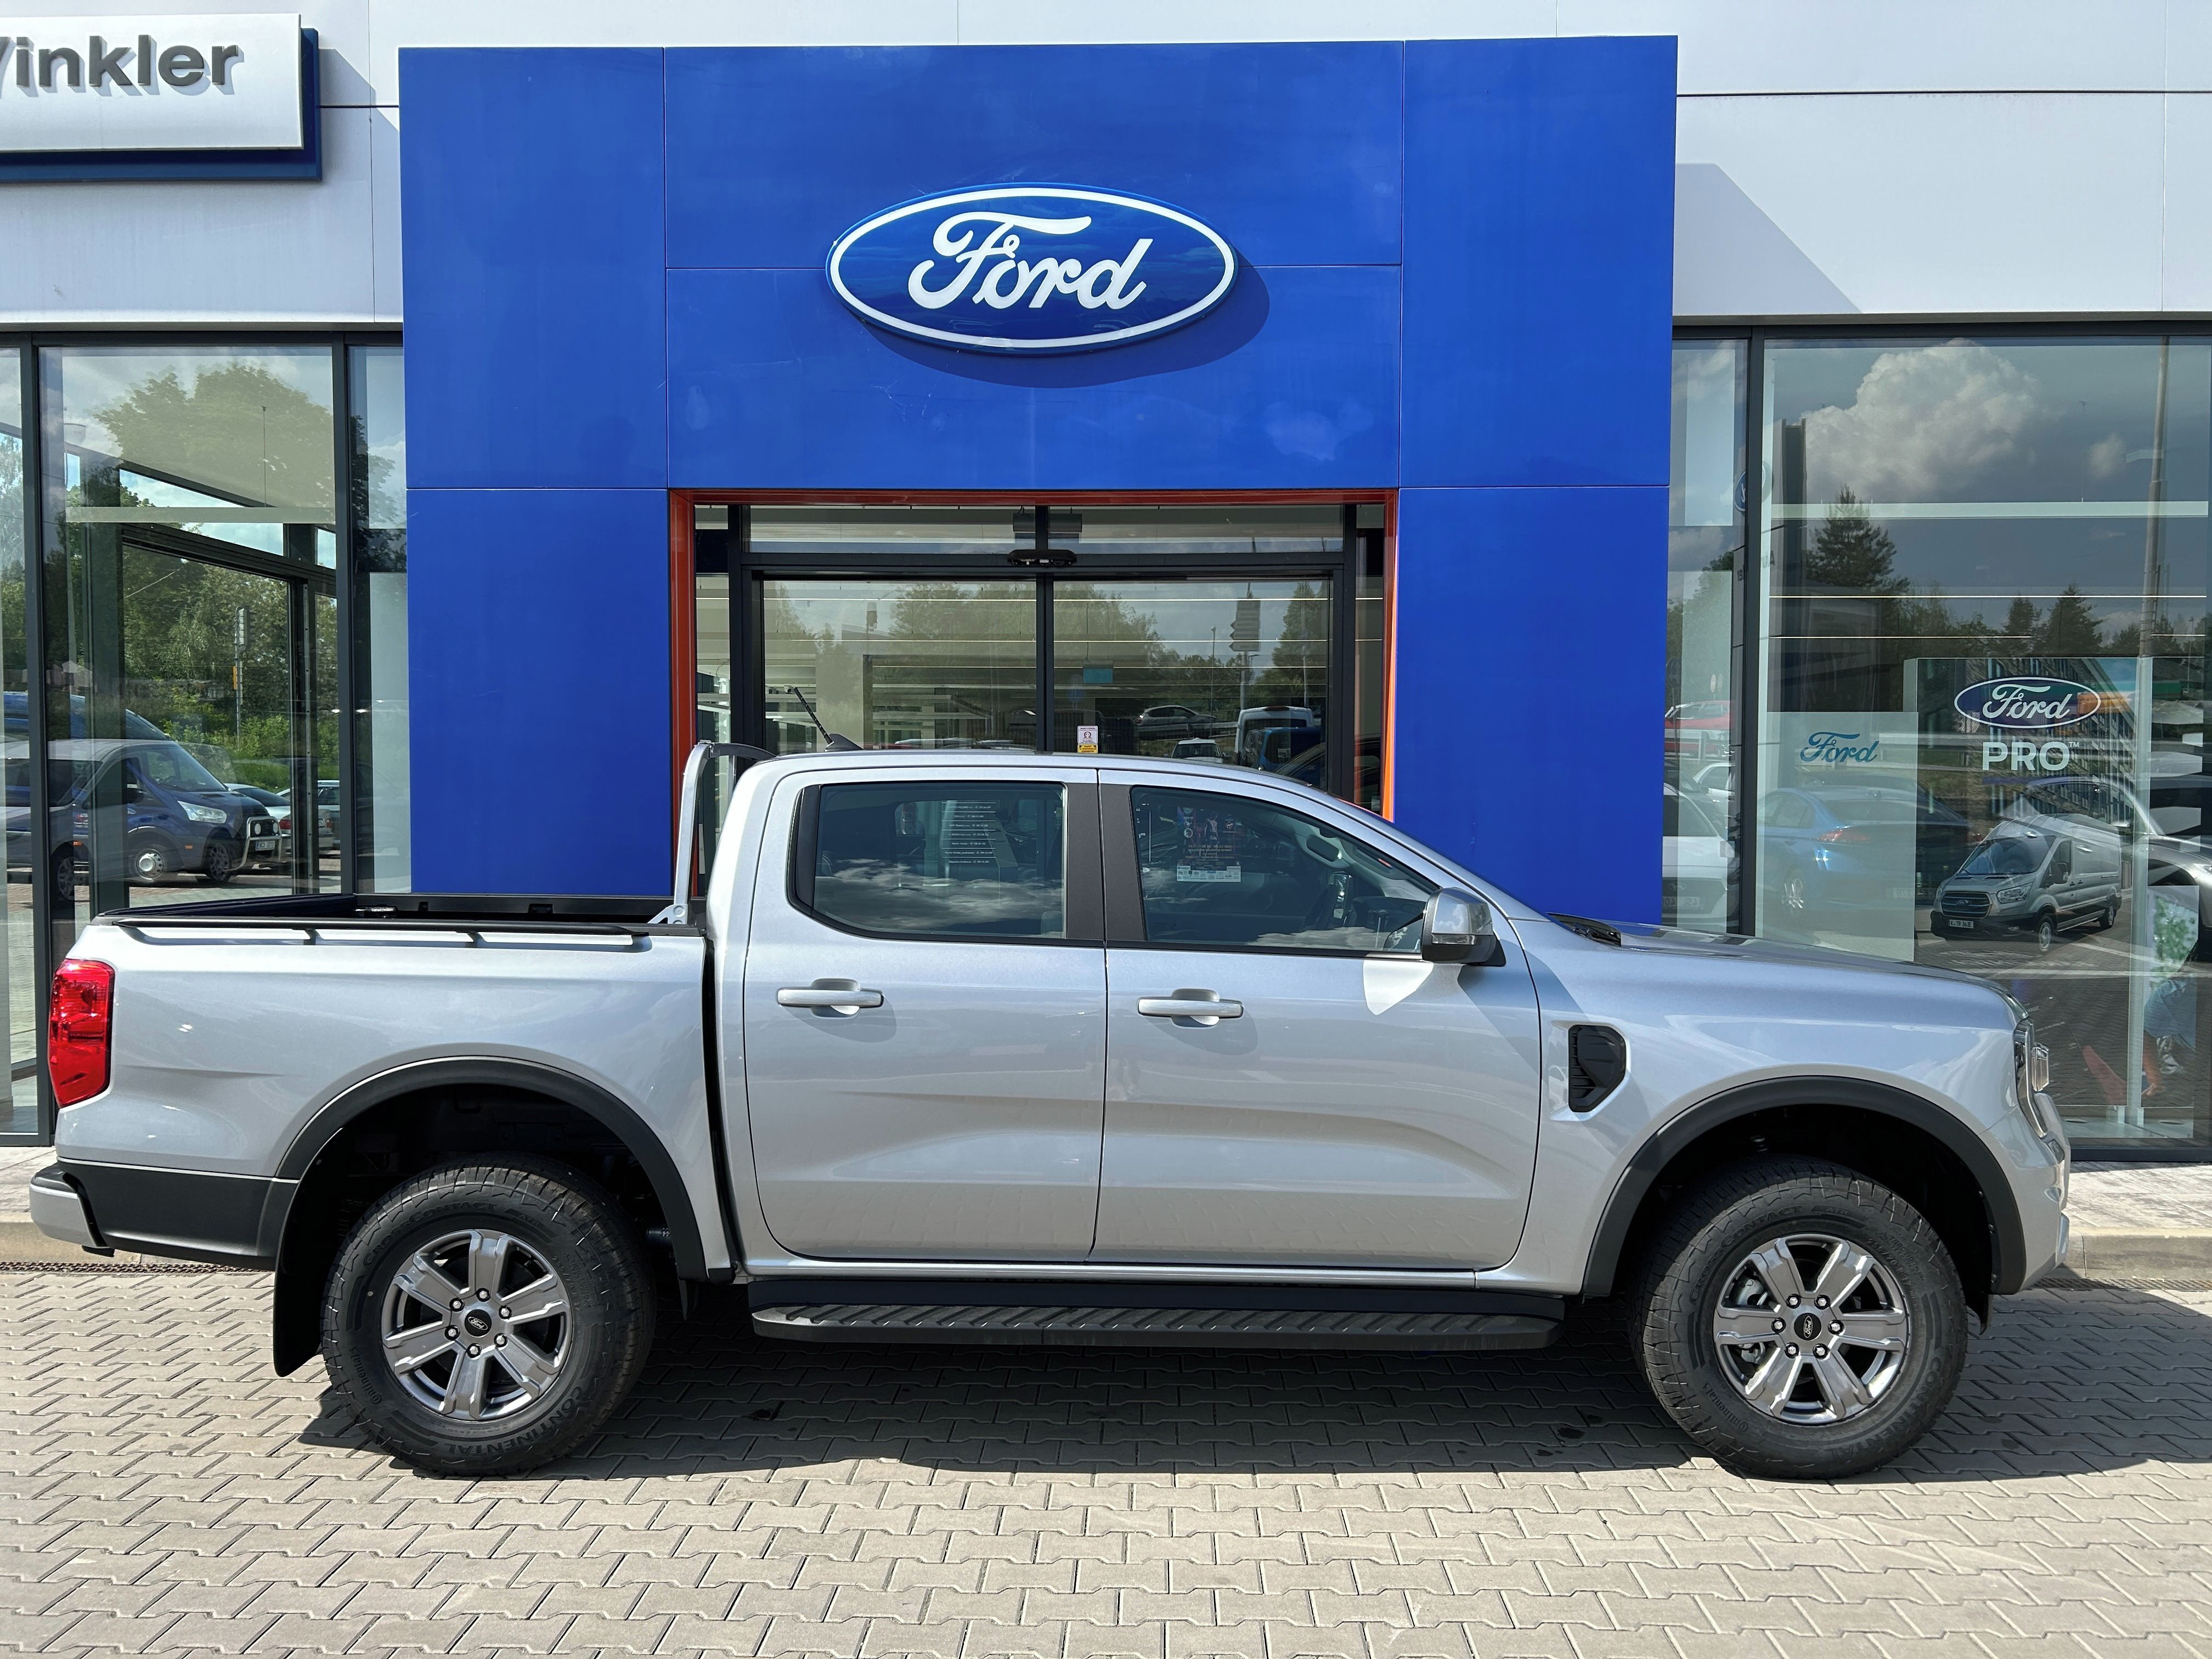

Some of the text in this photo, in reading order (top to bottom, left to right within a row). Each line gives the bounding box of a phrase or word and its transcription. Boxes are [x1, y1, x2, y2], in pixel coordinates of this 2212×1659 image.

[0, 35, 238, 87] inkler
[908, 212, 1154, 310] Ford
[1982, 684, 2072, 719] Ford
[1800, 731, 1879, 763] Ford
[351, 1353, 382, 1405] Continental
[443, 1385, 583, 1456] CONTINENTAL
[1705, 1388, 1749, 1432] Continental
[1824, 1356, 1942, 1459] CONTINENTAL
